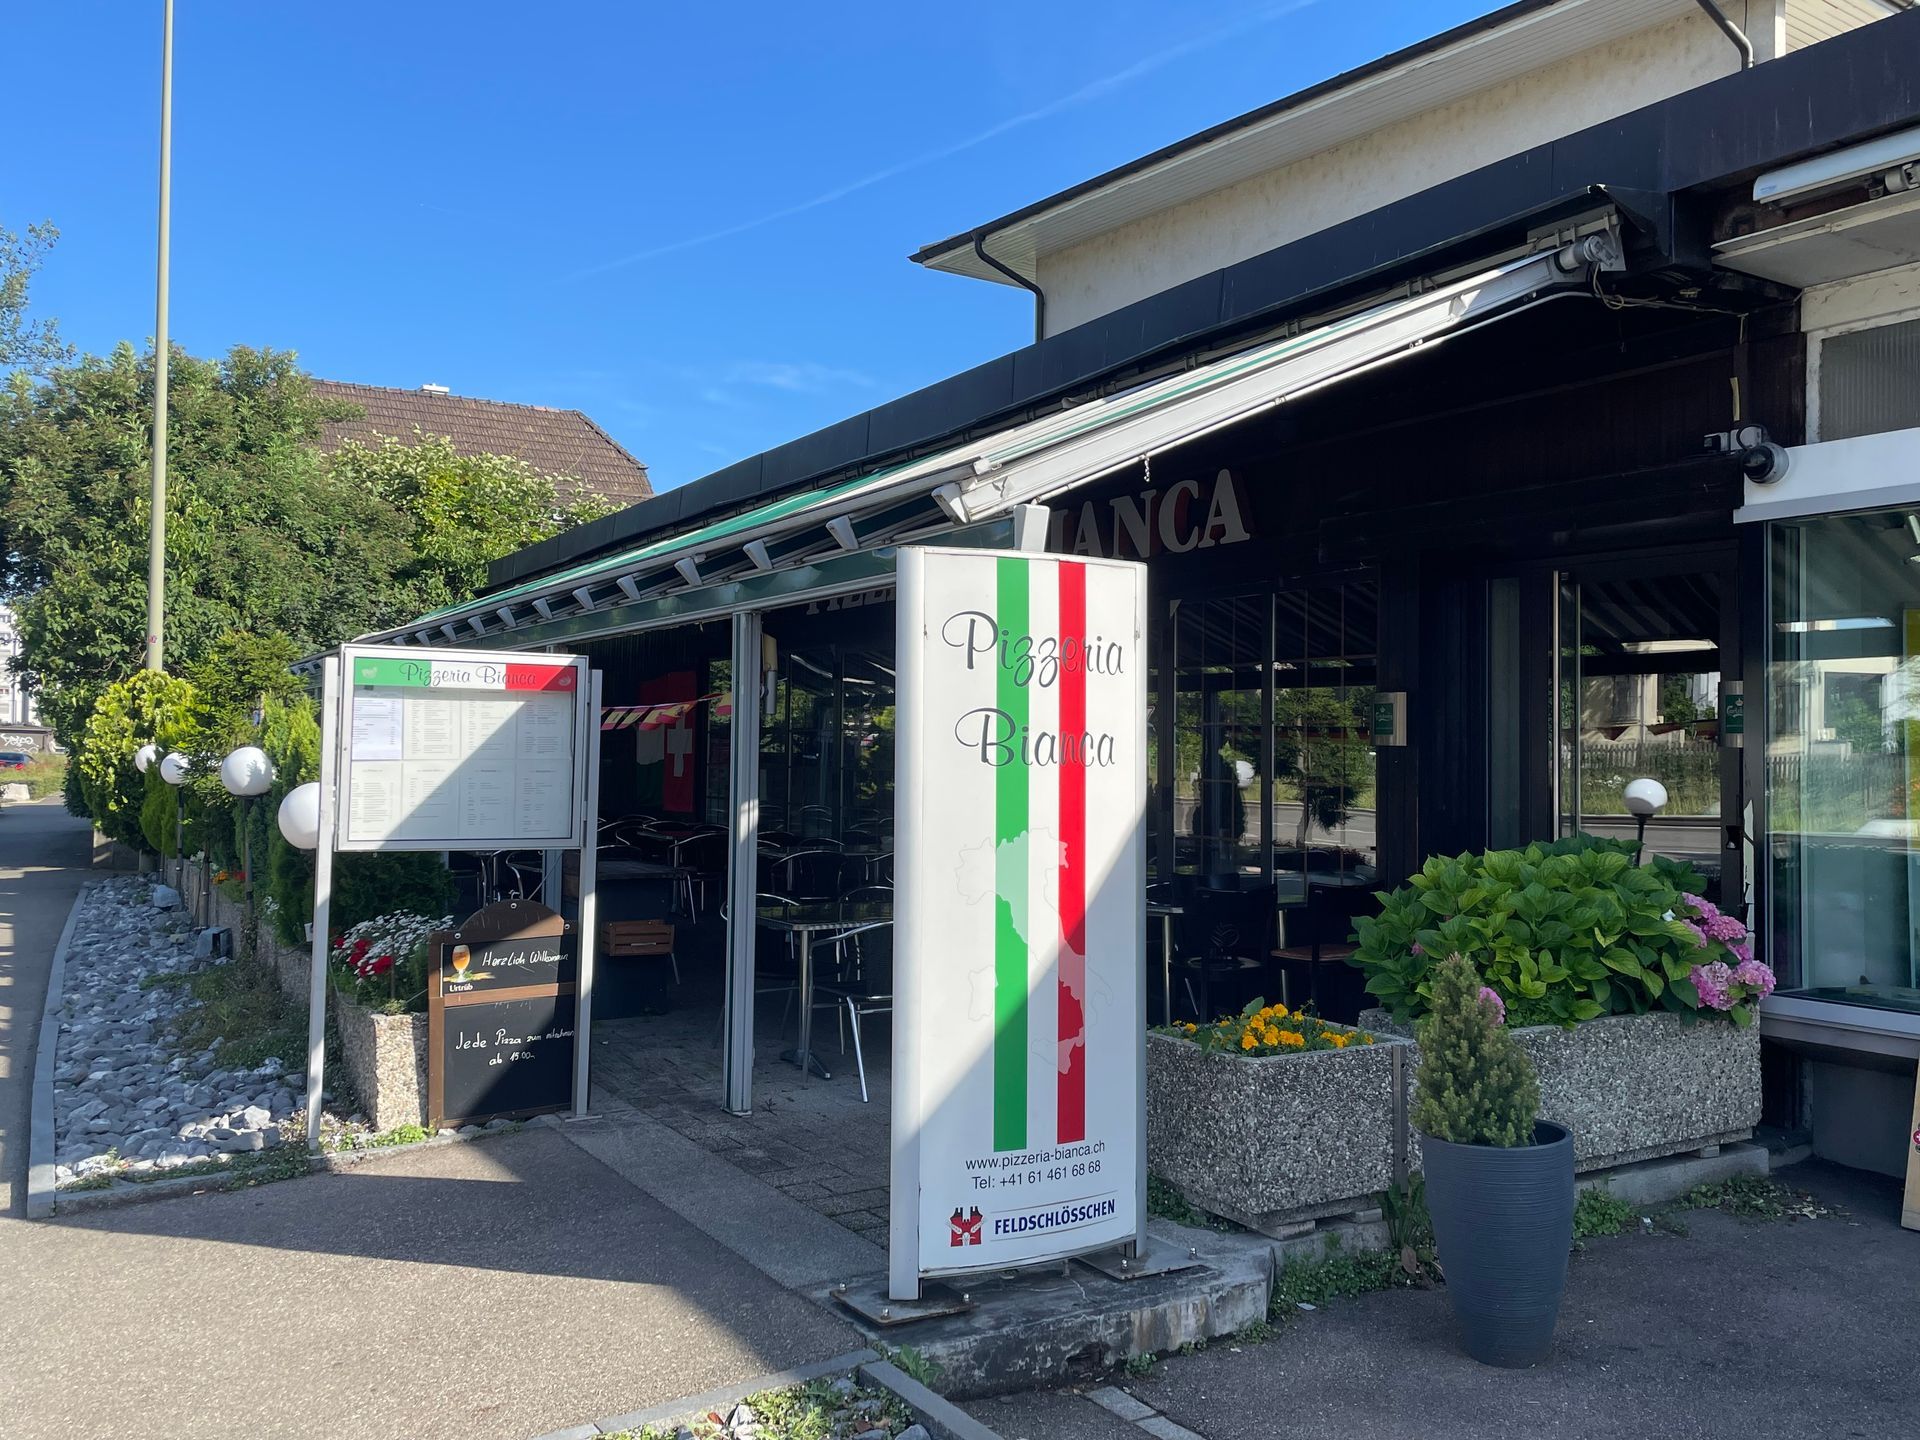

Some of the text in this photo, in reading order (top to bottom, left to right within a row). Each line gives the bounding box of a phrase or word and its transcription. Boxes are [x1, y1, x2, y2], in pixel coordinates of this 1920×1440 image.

[1050, 468, 1252, 559] IANCA
[941, 610, 1124, 688] Pizzeria
[399, 662, 537, 687] Pizzeria Bianca
[954, 707, 1116, 768] Bianca
[449, 982, 474, 993] Urtrüb
[455, 1031, 488, 1050] Jede
[494, 1028, 522, 1046] Pizza
[489, 1053, 503, 1066] ab
[965, 1140, 1105, 1170] www.pizzeria-bianca.ch
[972, 1159, 1102, 1190] Tel: +41 61 461 68 68
[995, 1198, 1116, 1235] FELDSCHLÖSSCHEN
